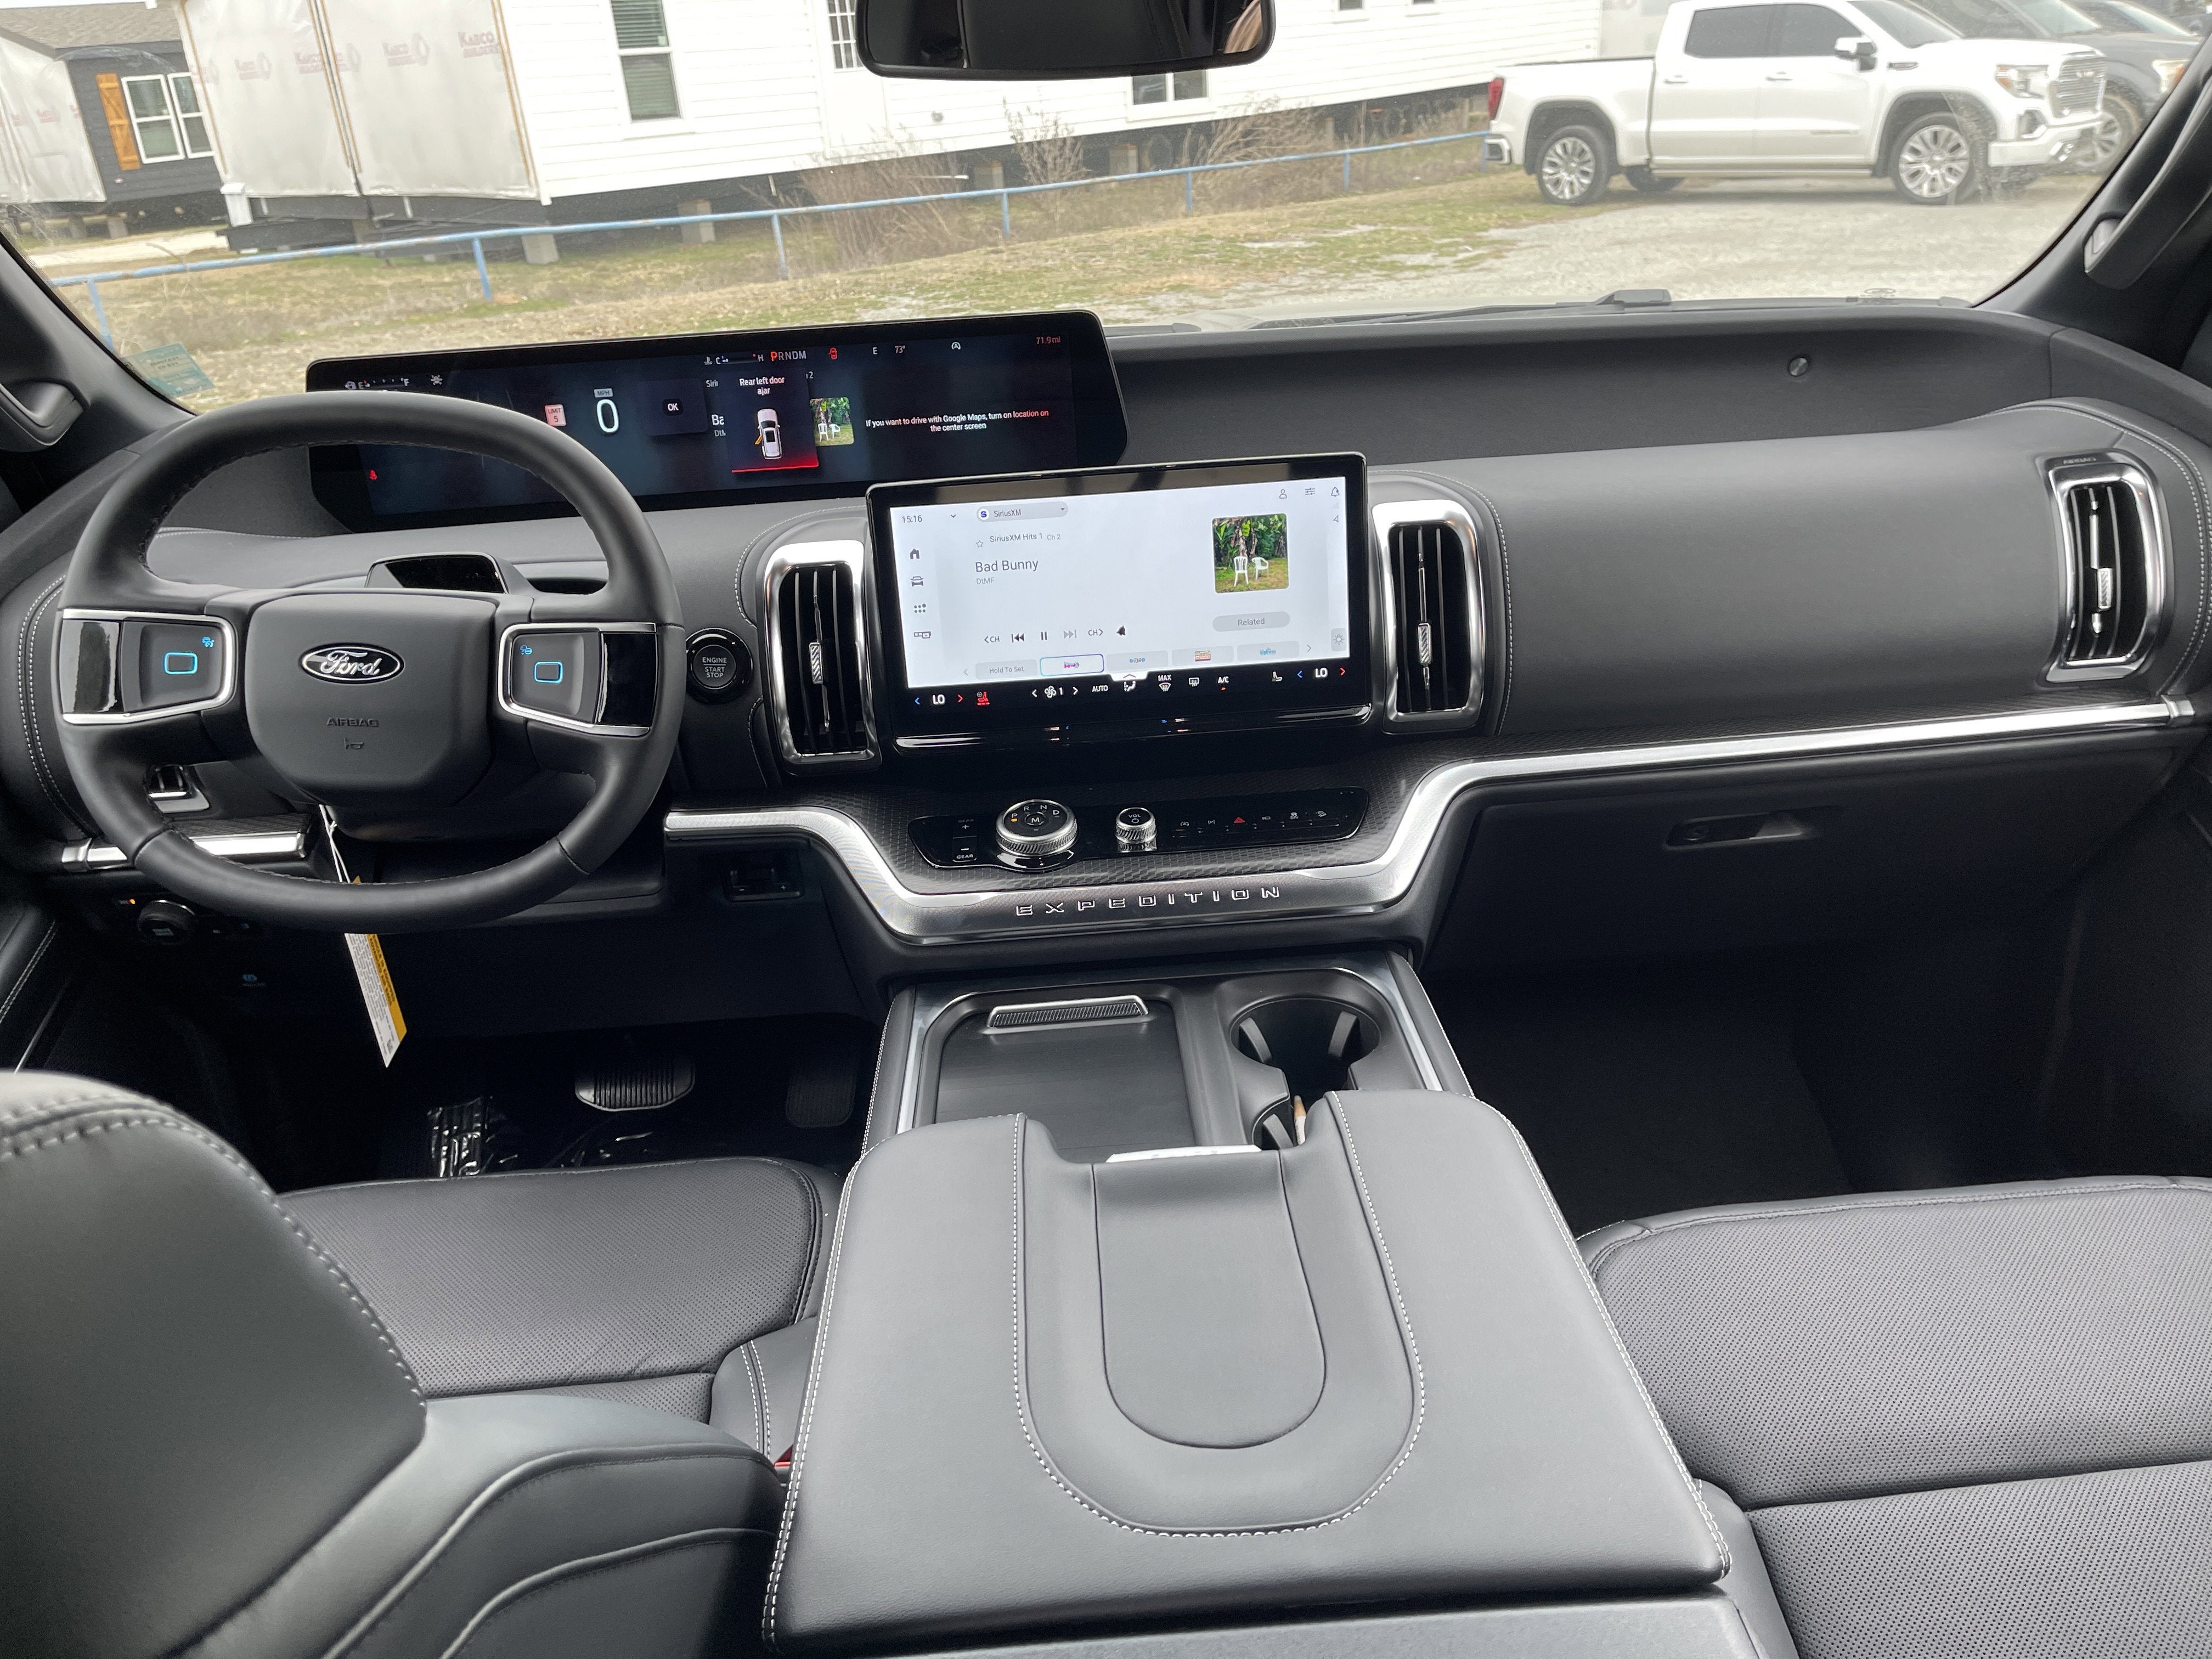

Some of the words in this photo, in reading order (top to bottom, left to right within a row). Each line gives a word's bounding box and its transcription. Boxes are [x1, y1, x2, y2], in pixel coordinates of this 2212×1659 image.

[871, 347, 878, 355] E
[894, 345, 906, 354] 73°
[739, 376, 755, 387] Rear
[755, 376, 769, 385] left
[769, 376, 785, 385] door
[757, 386, 771, 396] ajar
[667, 403, 679, 411] OK
[596, 399, 619, 433] 0
[872, 420, 884, 428] you
[911, 416, 927, 425] drive
[928, 415, 942, 424] with
[943, 413, 967, 424] Google
[967, 413, 988, 422] Maps,
[942, 424, 963, 432] center
[994, 509, 1022, 518] SiriusXM
[901, 515, 923, 523] 15:16
[990, 534, 1021, 543] SiriusXM
[975, 560, 998, 573] Bad
[1002, 560, 1039, 572] Bunny
[1237, 617, 1266, 627] Related
[320, 650, 382, 676] Ford
[1315, 667, 1328, 678] LO
[932, 694, 946, 705] LO
[326, 717, 379, 727] AIRBAG
[1016, 887, 1280, 916] EXPEDITION
